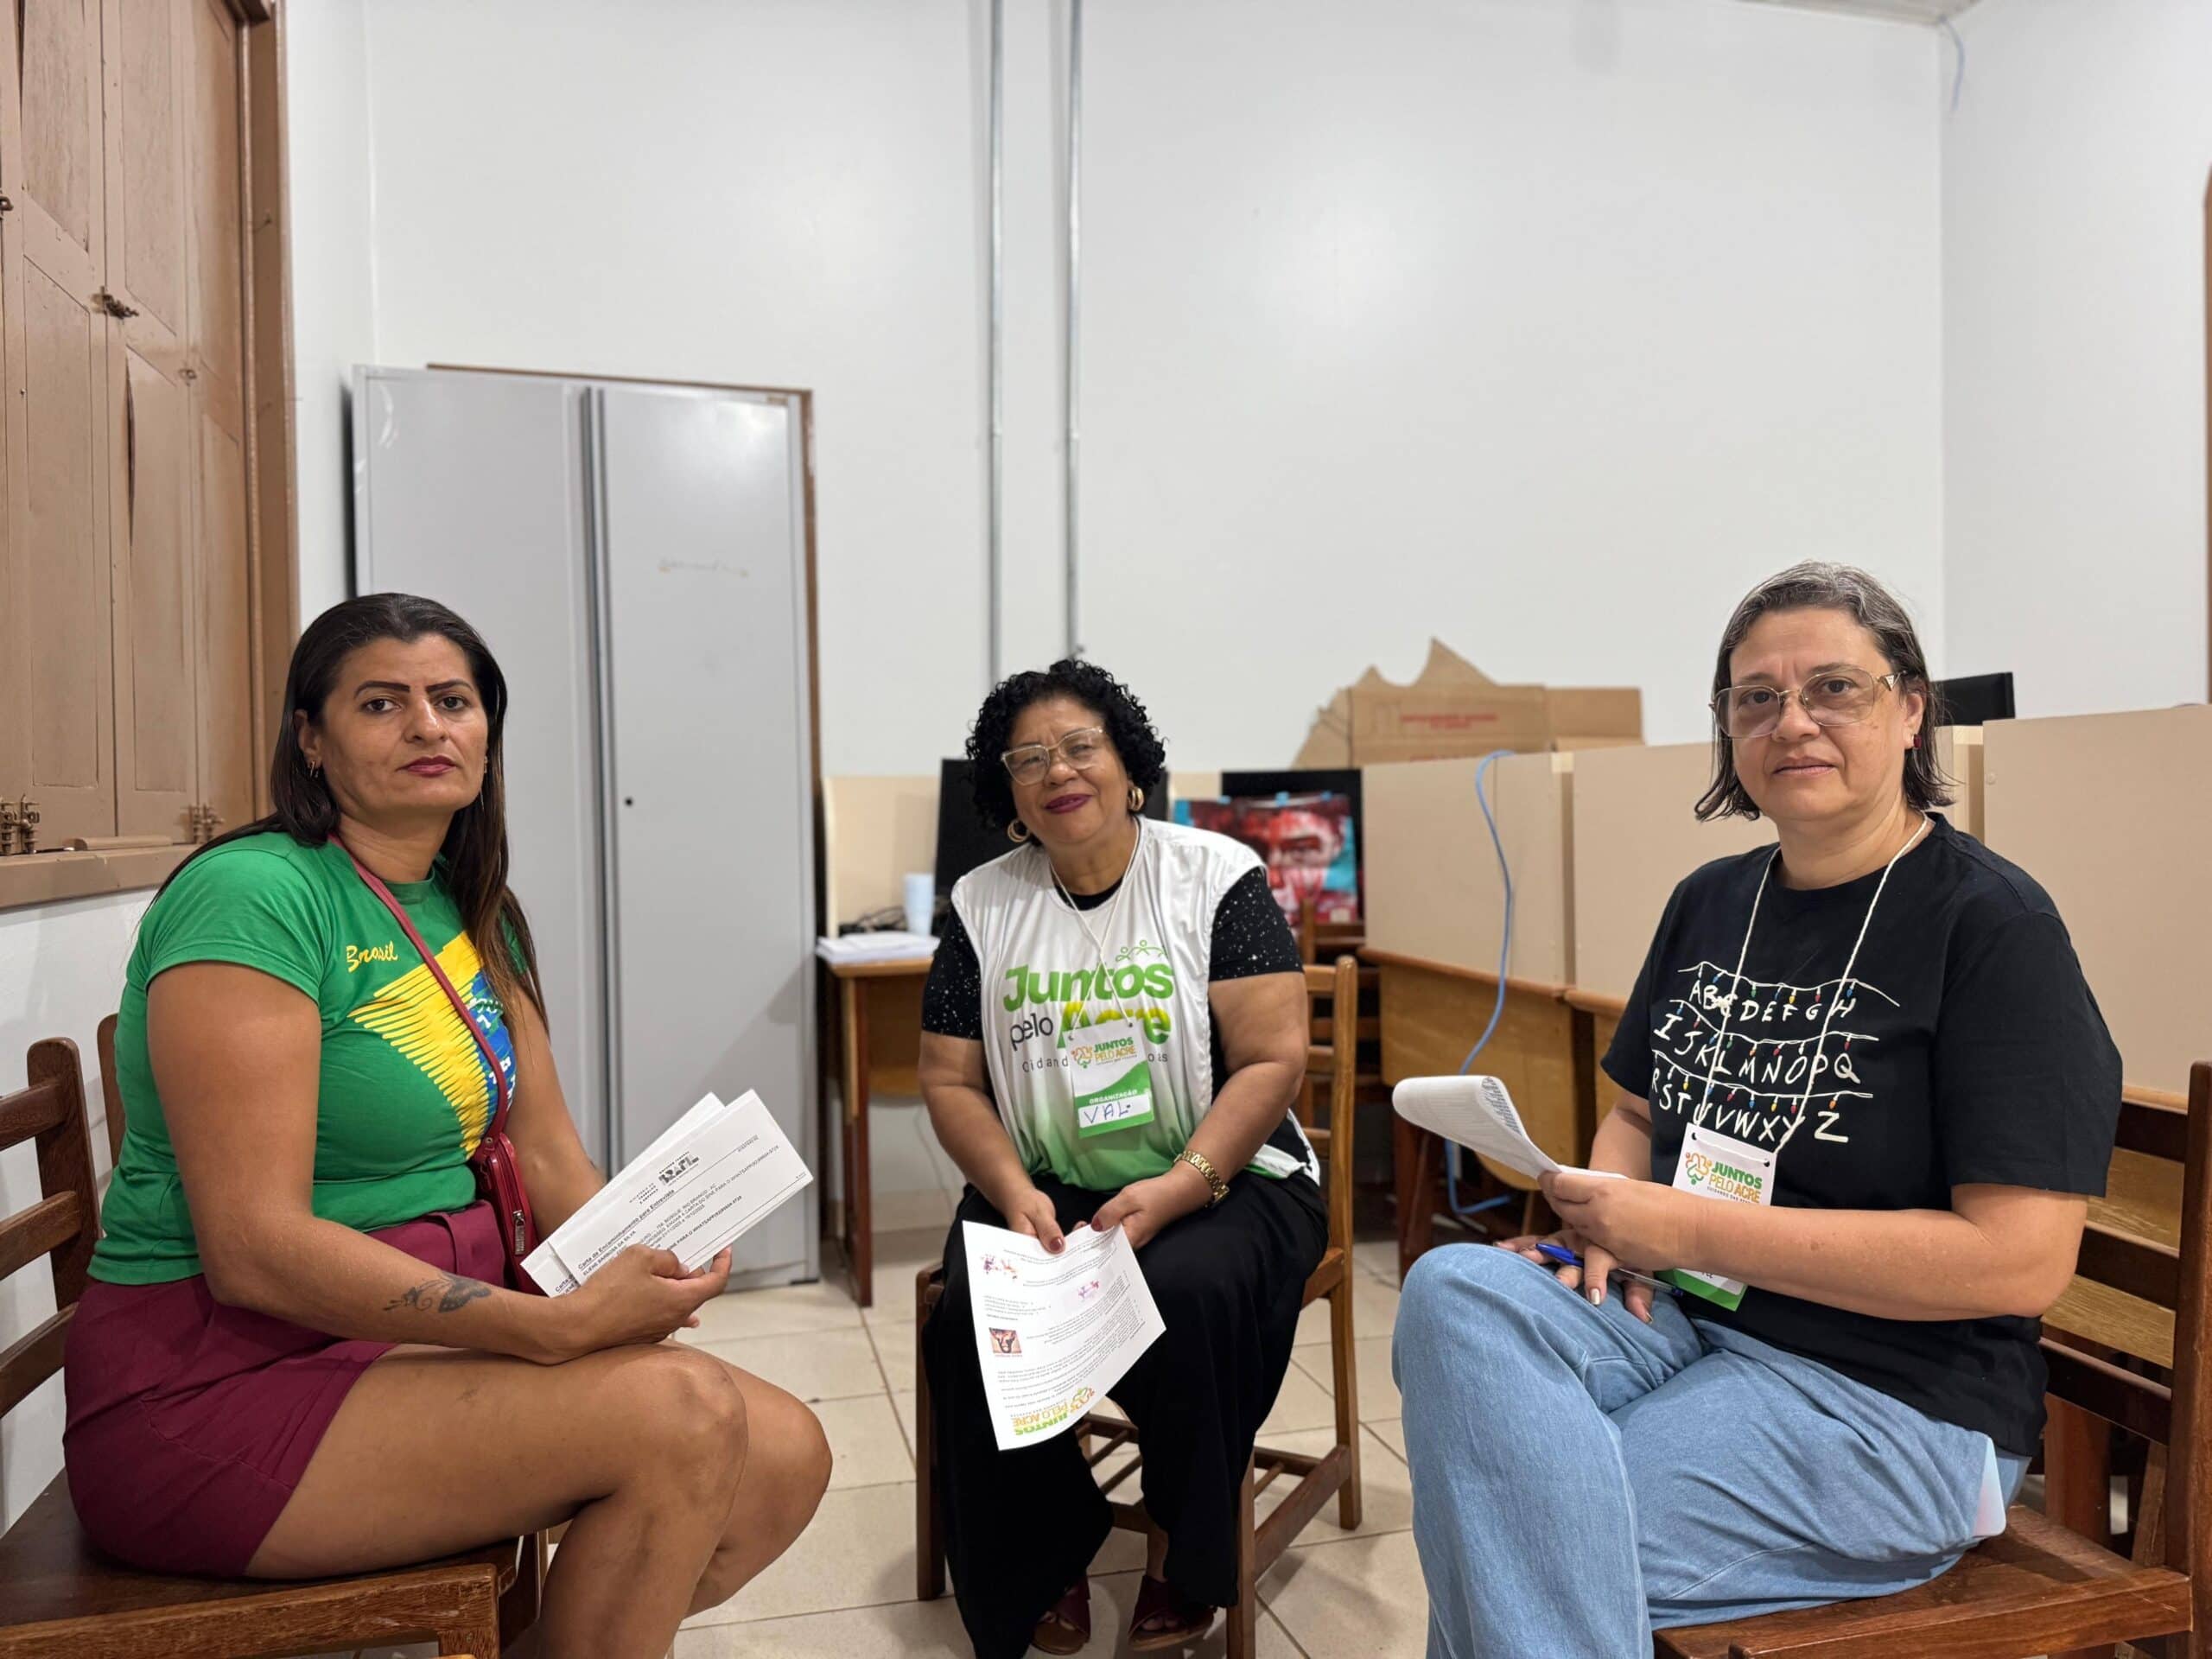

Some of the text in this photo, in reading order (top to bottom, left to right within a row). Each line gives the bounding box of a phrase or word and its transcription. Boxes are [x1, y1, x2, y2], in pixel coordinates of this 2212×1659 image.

[346, 941, 398, 973] Brasil
[1003, 963, 1174, 1012] Juntos
[1010, 1013, 1053, 1051] pelo
[1094, 1037, 1134, 1052] JUNTOS
[1708, 1174, 1762, 1204] PELO ACRE
[1711, 1161, 1763, 1190] JUNTOS
[577, 1256, 592, 1269] Carta
[598, 1217, 639, 1252] Encaminhamento
[639, 1208, 651, 1219] para
[649, 1188, 675, 1210] Entrevista
